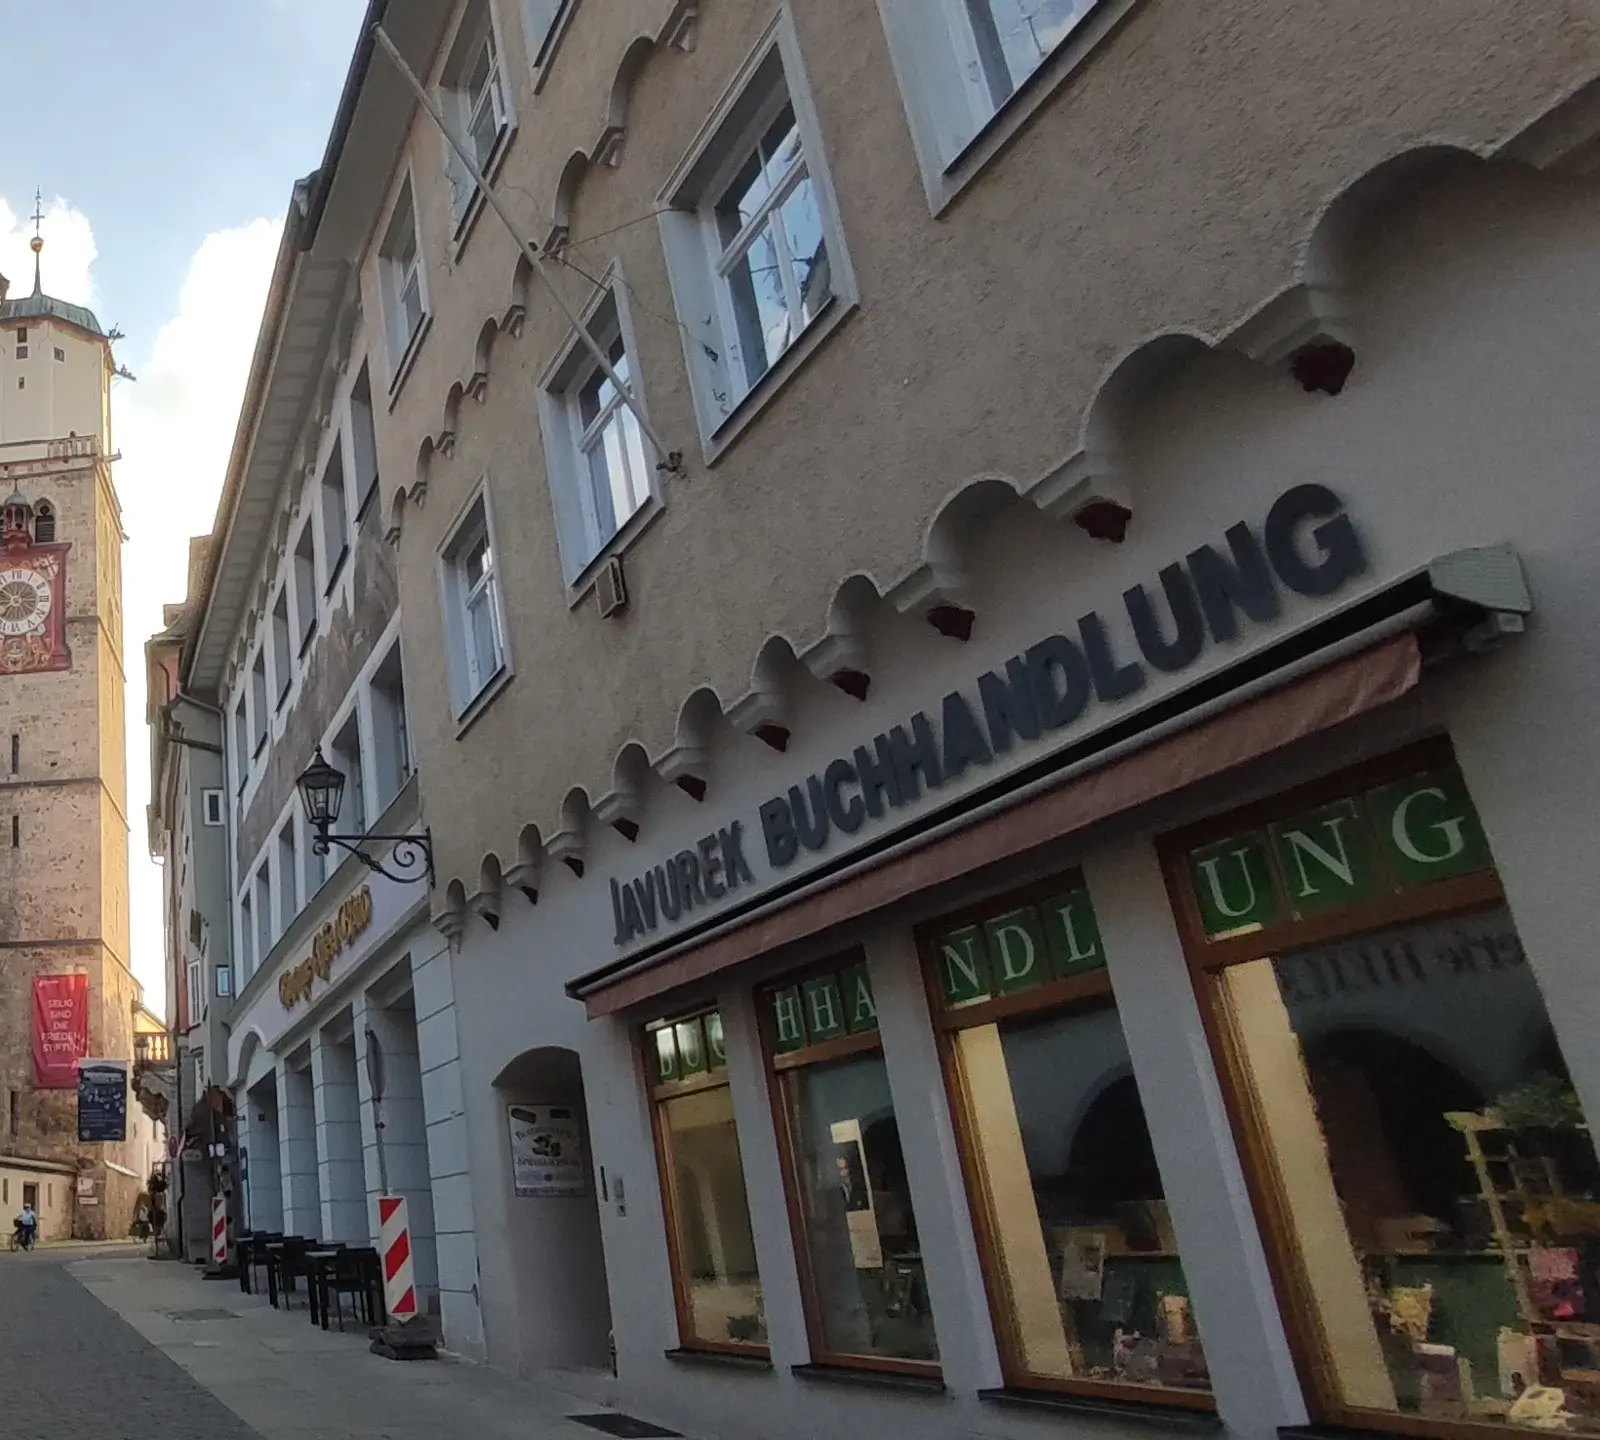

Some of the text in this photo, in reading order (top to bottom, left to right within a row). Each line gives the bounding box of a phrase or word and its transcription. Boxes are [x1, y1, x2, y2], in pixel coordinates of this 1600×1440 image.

[609, 483, 1369, 946] JAVUREK BUCHHANDLUNG
[774, 984, 878, 1043] HHA
[940, 904, 1096, 995] NDL
[1198, 787, 1465, 917] UNG
